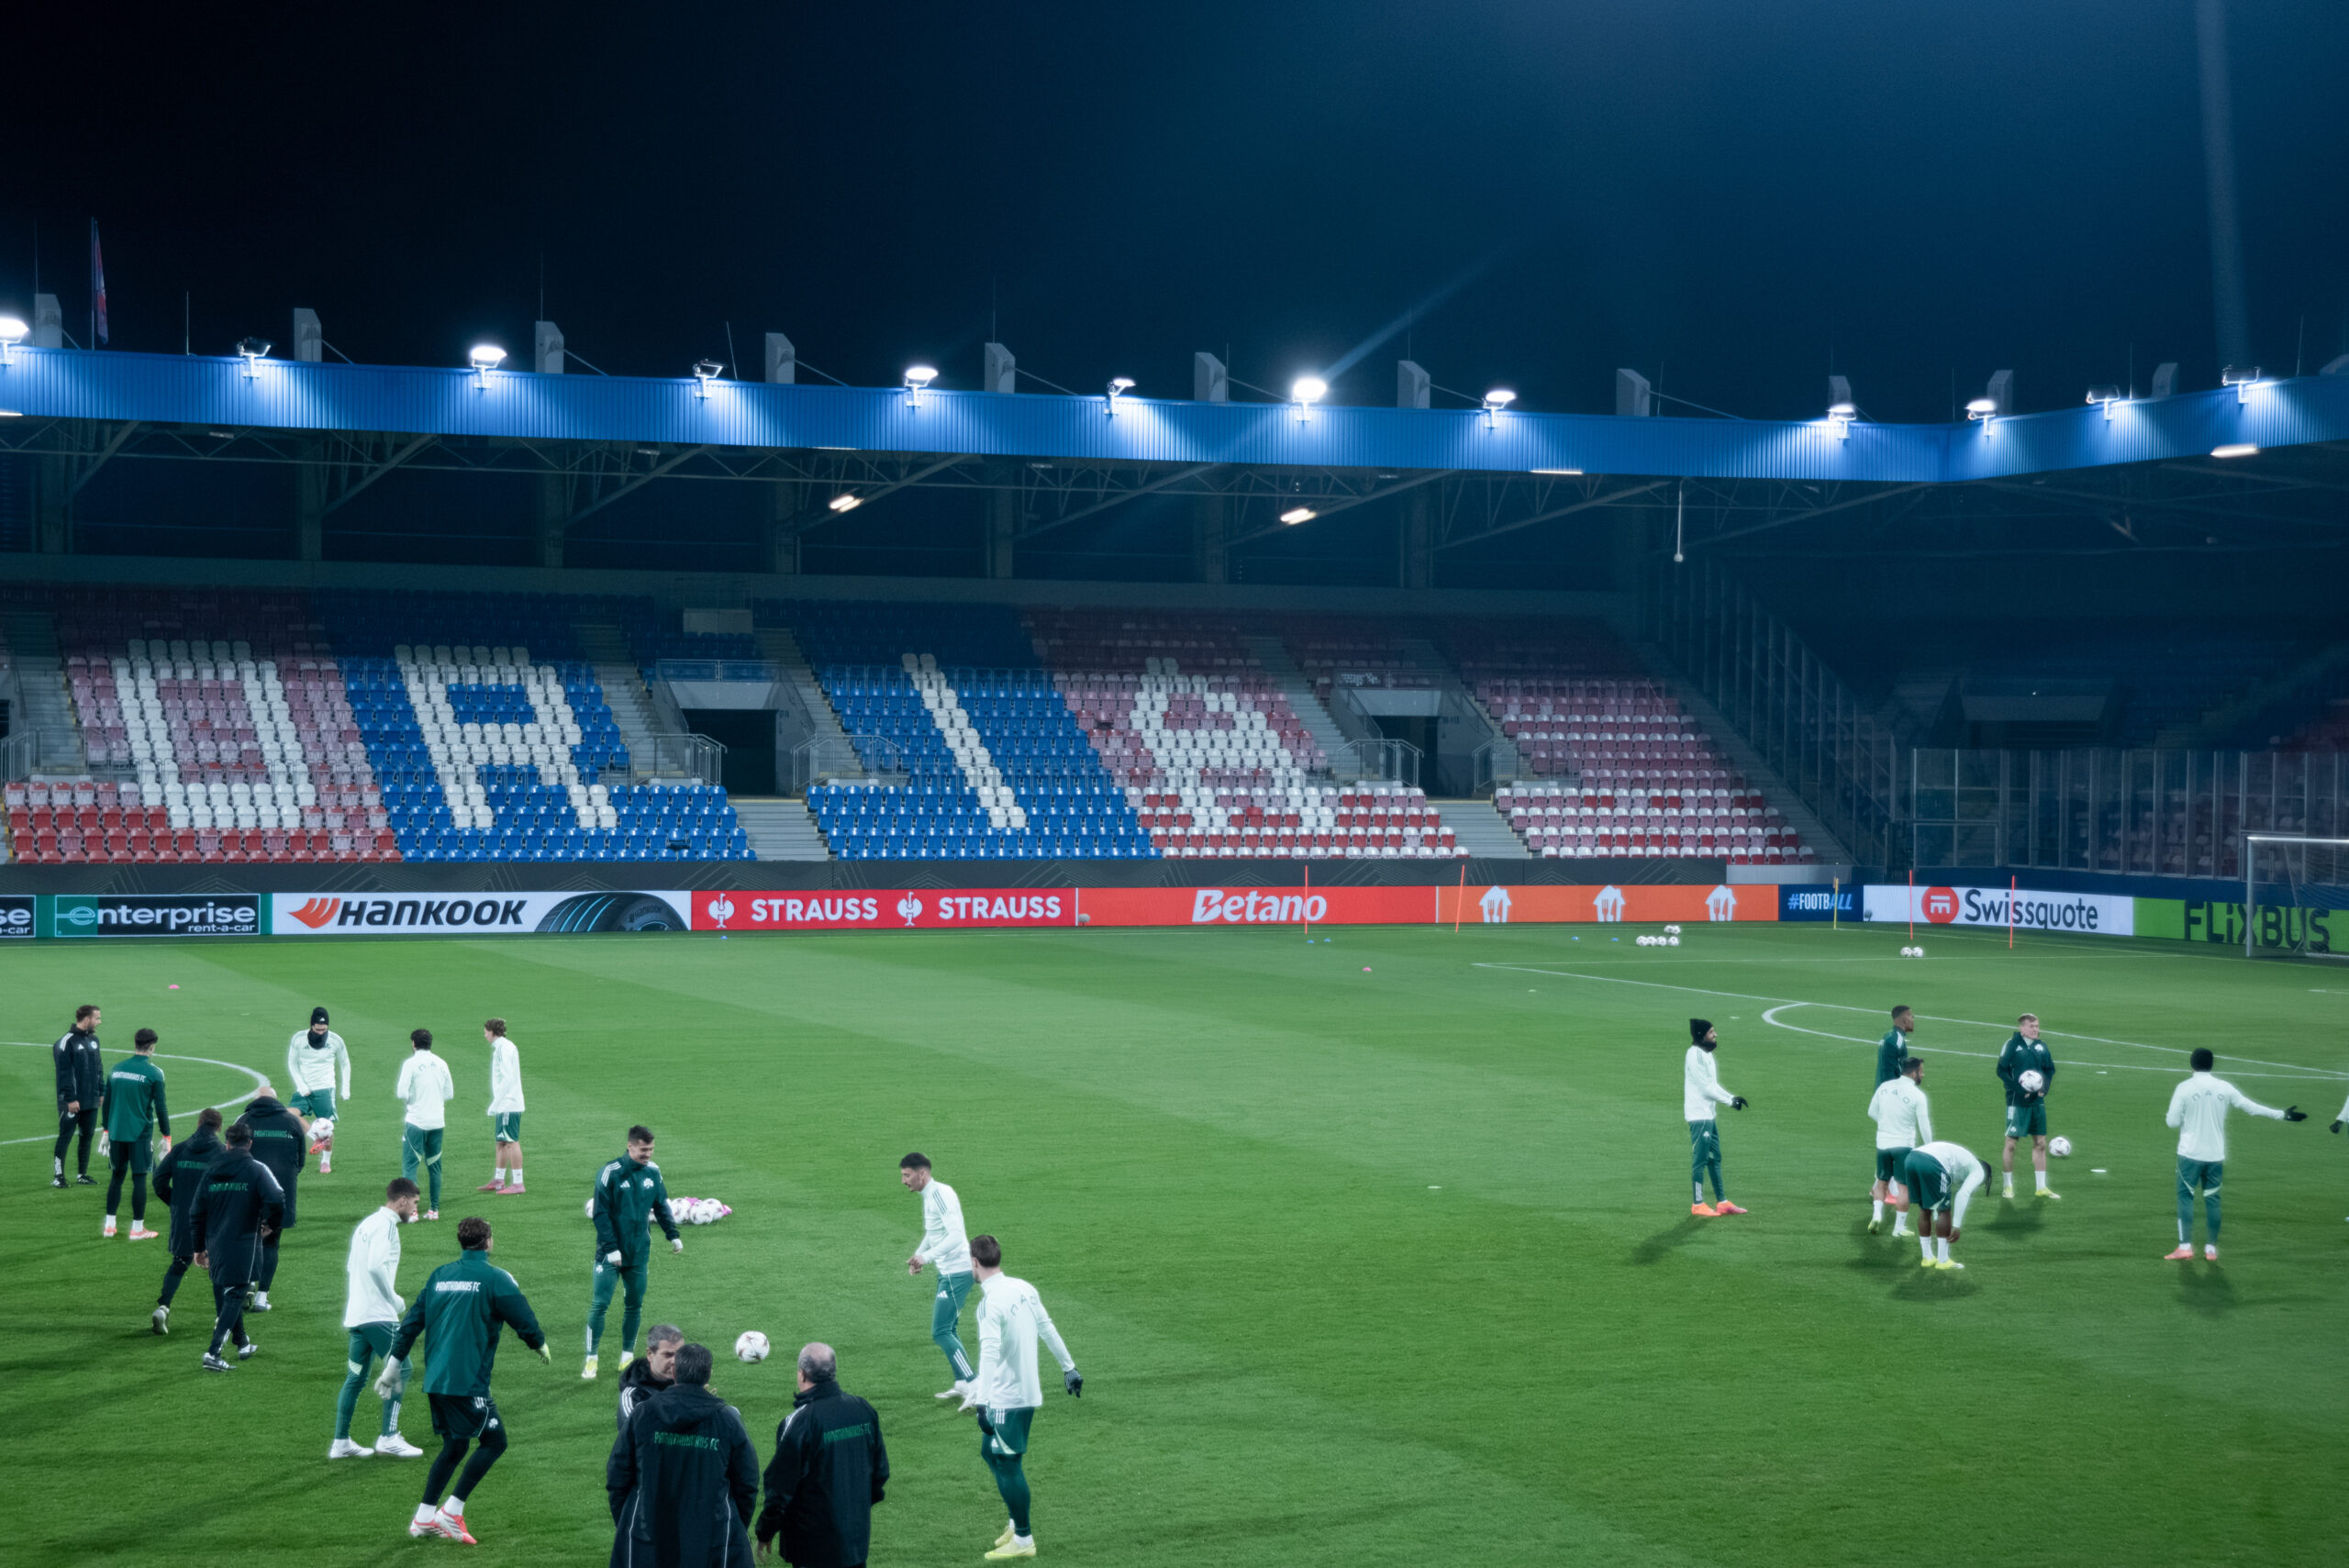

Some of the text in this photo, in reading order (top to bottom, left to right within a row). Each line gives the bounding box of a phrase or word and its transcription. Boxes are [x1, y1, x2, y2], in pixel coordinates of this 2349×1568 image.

[751, 897, 878, 922] STRAUSS
[938, 895, 1062, 920] STRAUSS
[1191, 889, 1328, 922] Betano
[1787, 893, 1853, 910] #FOOTBALL
[1964, 888, 2099, 930] Swissquote
[69, 901, 256, 930] enterprise
[188, 923, 256, 933] rent-a-car
[473, 1282, 482, 1293] FC
[709, 1438, 720, 1451] FC
